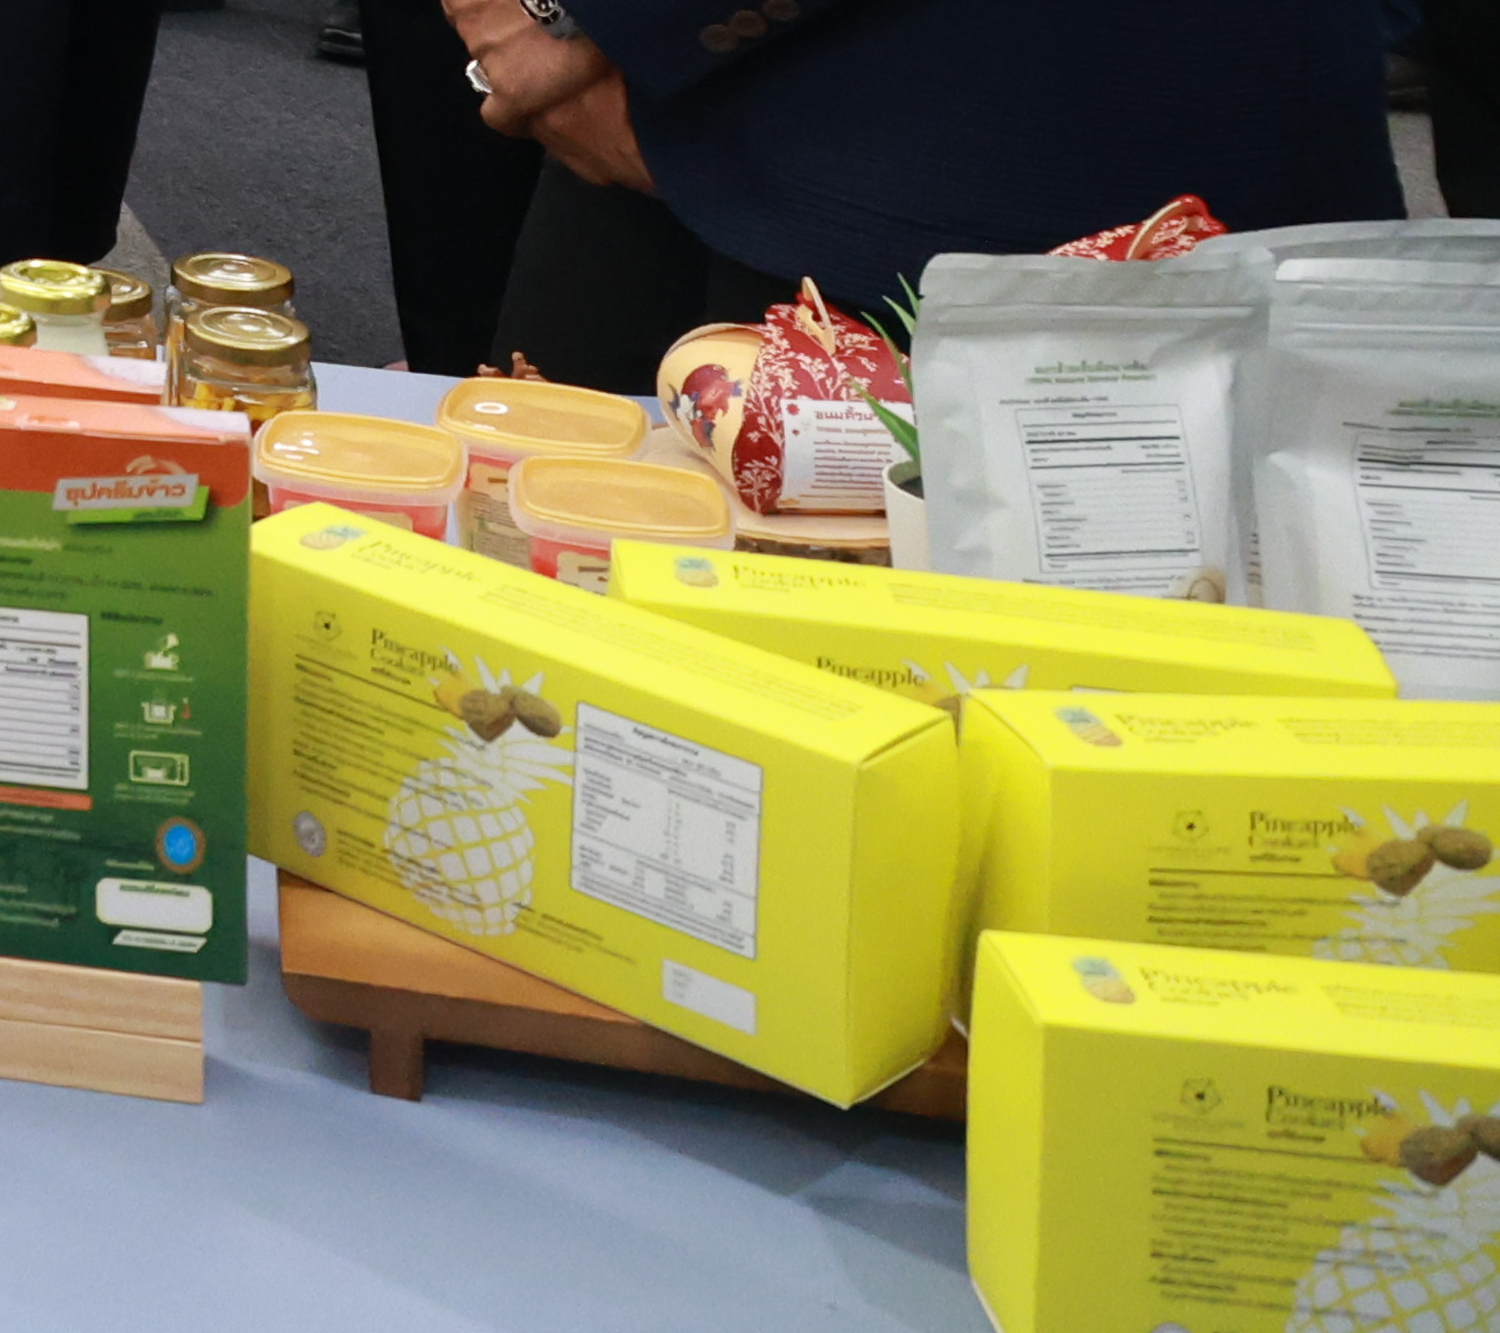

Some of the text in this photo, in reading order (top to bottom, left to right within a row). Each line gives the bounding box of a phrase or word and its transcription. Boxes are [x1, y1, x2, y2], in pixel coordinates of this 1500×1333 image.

[65, 477, 187, 506] ซุปครีมข้าว
[371, 627, 461, 675] Pineapple
[815, 655, 925, 687] Pineapple
[1248, 810, 1358, 839] Pineapple
[1267, 1084, 1388, 1120] Pineapple
